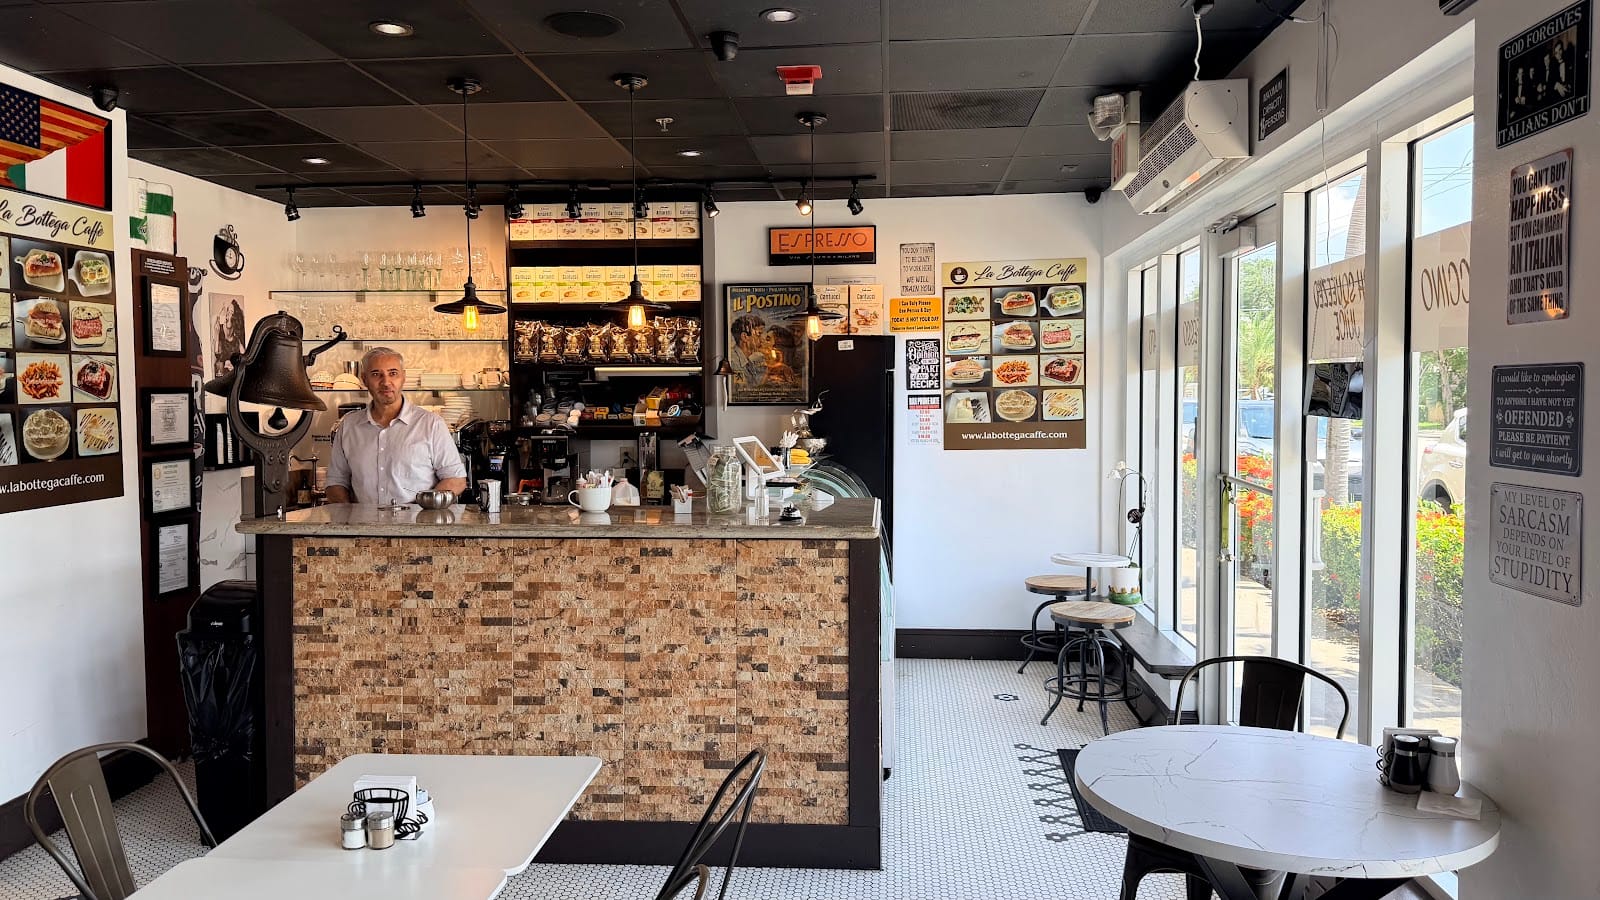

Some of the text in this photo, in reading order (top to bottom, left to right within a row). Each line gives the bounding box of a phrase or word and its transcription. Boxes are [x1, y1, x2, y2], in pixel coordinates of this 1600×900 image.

[1505, 7, 1582, 59] GOD FORGIVES
[1498, 95, 1587, 145] ITALIANS DON'T
[1512, 160, 1567, 196] YOU CAN'T BUY
[1511, 185, 1565, 221] HAPPINESS
[15, 205, 70, 238] Bottega
[1511, 213, 1564, 242] BUT YOU CAN MARRY
[779, 232, 867, 252] ESPRESSO
[1510, 234, 1562, 275] AN ITALIAN
[973, 265, 994, 282] La
[996, 265, 1044, 282] Bottega
[1510, 271, 1562, 295] AND THAT'S KIND
[733, 293, 802, 313] IL POSTINO
[1510, 292, 1563, 315] OF THE SAME THING
[921, 365, 939, 373] PART
[1501, 372, 1520, 383] would
[1520, 371, 1532, 383] like
[1533, 373, 1540, 382] to
[1542, 370, 1575, 386] apologise
[910, 380, 939, 389] RECIPE
[1497, 397, 1504, 405] TO
[1531, 397, 1547, 406] HAVE
[1547, 398, 1561, 406] NOT
[1562, 398, 1575, 407] YET
[1504, 410, 1564, 427] OFFENDED
[962, 431, 1067, 440] www.labottegacaffe.com
[1498, 431, 1570, 446] PLEASE BE PATIENT
[1499, 447, 1511, 458] will
[1512, 451, 1522, 463] get
[1523, 451, 1530, 460] to
[1532, 453, 1545, 465] you
[1546, 451, 1573, 469] shortly
[1504, 490, 1567, 511] MY LEVEL OF
[1499, 504, 1570, 536] SARCASM
[1503, 527, 1564, 550] DEPENDS ON
[1497, 540, 1571, 569] YOUR LEVEL OF
[1494, 555, 1573, 593] STUPIDITY
